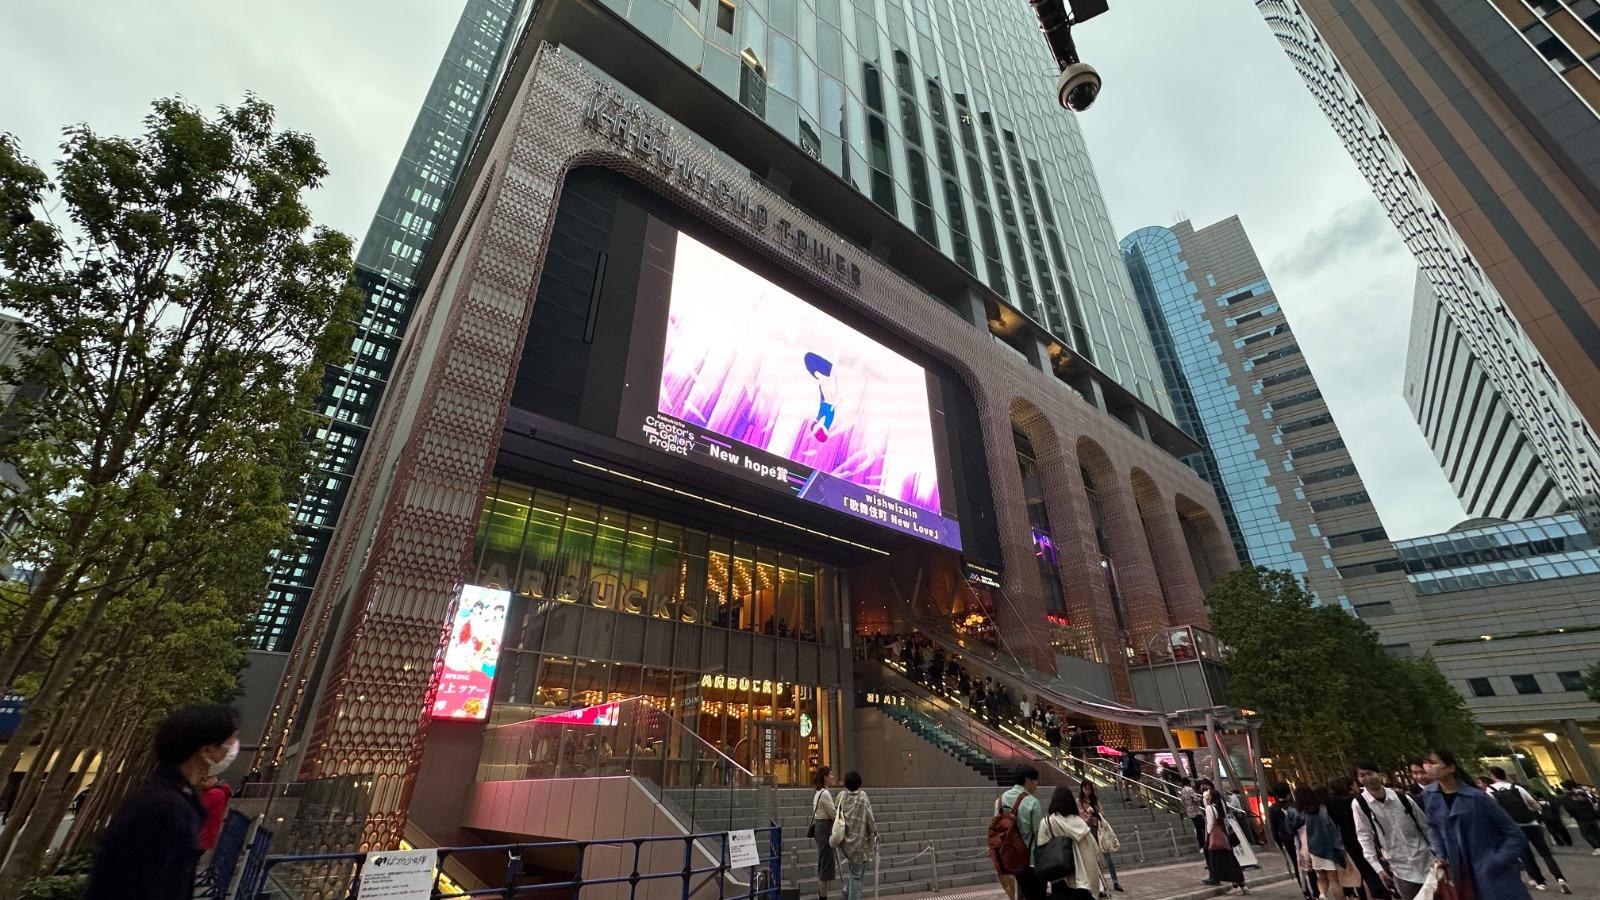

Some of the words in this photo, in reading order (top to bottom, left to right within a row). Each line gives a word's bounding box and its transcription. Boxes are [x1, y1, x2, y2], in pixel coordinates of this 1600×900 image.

[585, 94, 768, 226] KABUKICHO
[777, 217, 861, 286] TOWER
[646, 416, 695, 440] Creator's
[649, 434, 688, 456] Project
[659, 430, 696, 451] Gallery
[709, 443, 740, 465] New
[865, 494, 918, 519] wishwizain
[890, 513, 910, 529] New
